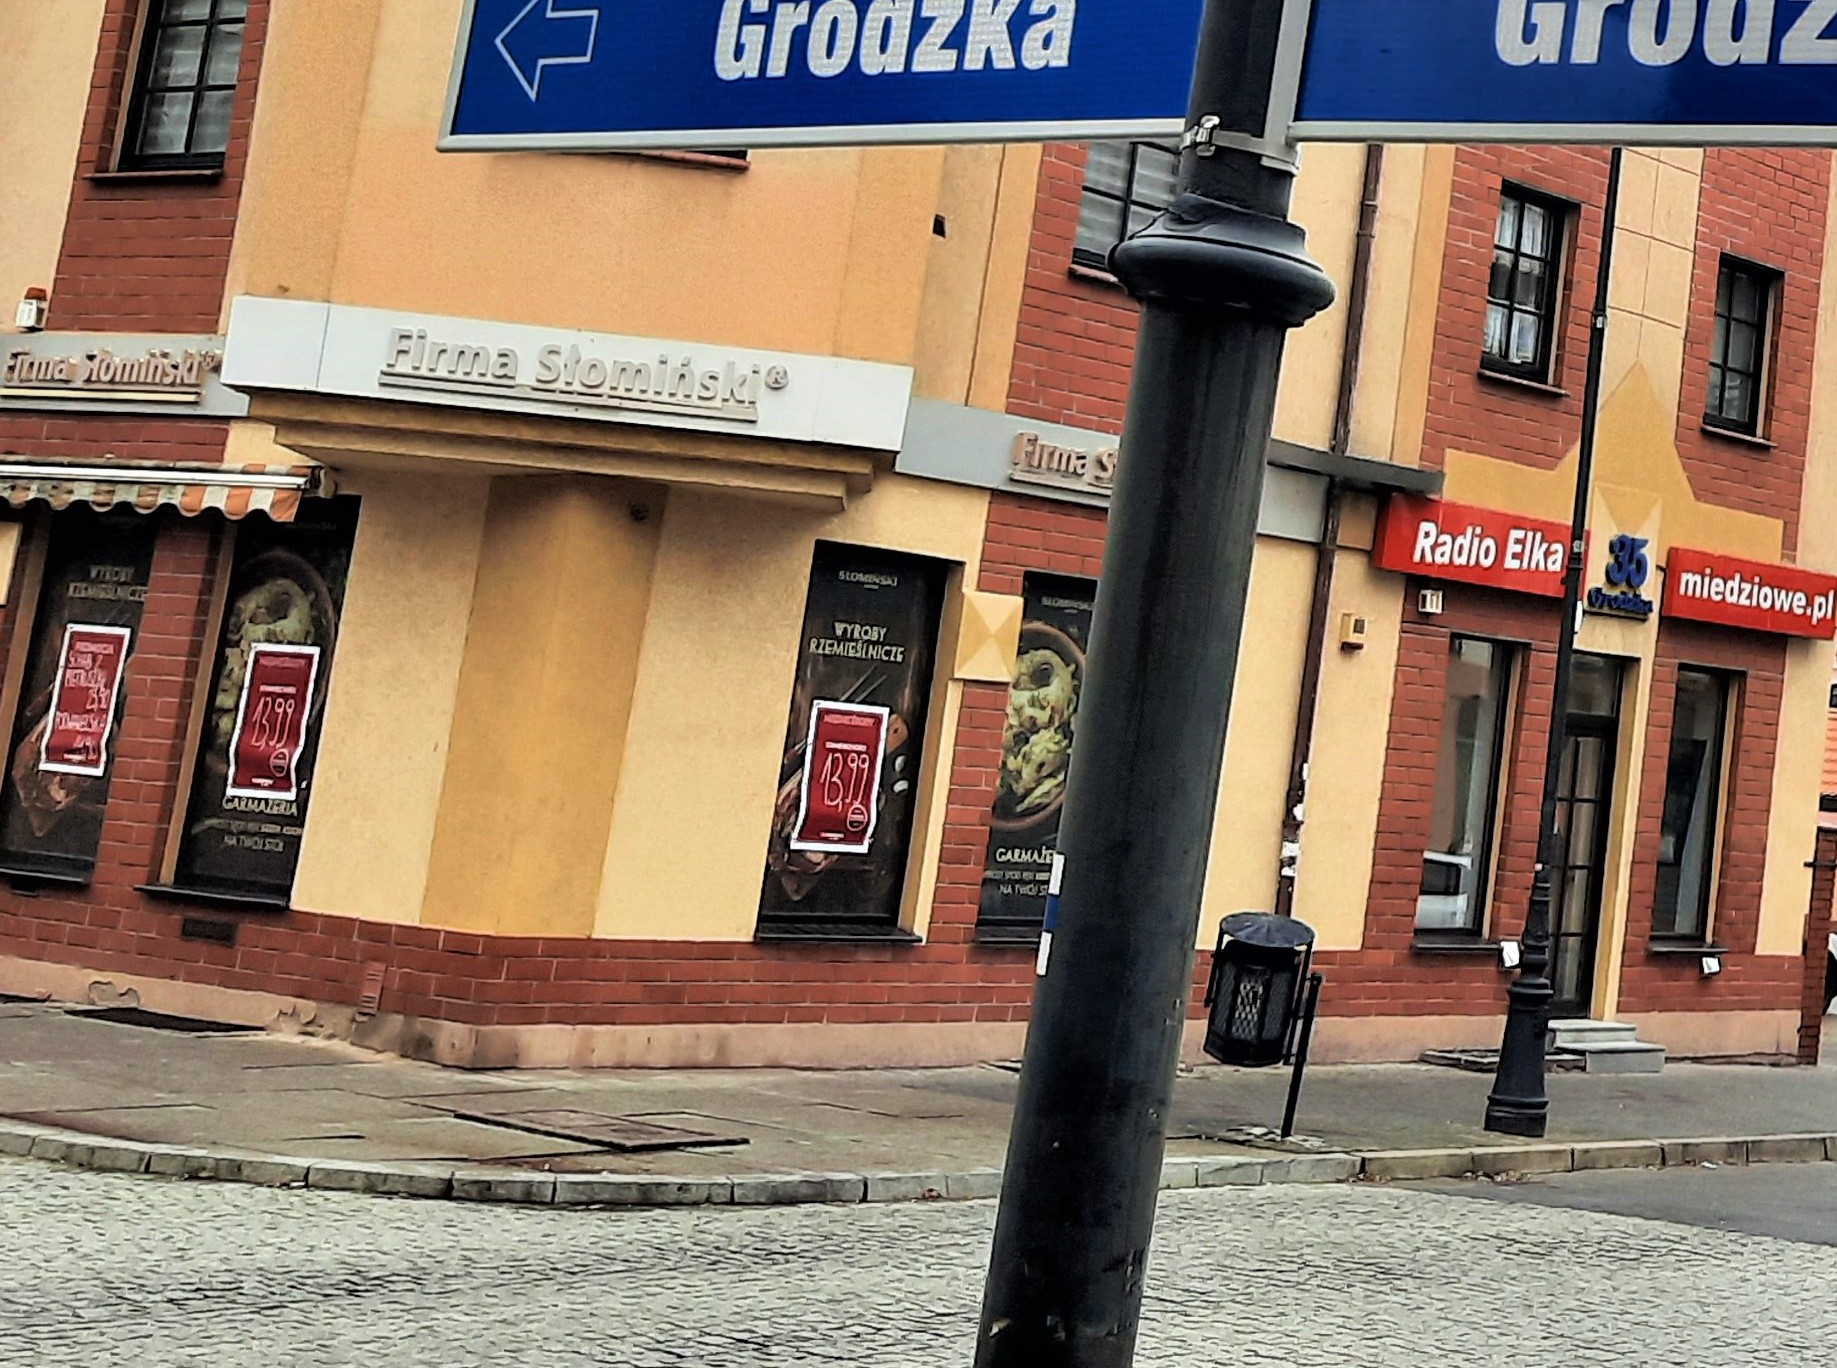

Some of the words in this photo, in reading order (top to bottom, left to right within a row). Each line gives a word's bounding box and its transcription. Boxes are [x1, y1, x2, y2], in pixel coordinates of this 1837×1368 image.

[386, 327, 518, 379] Firma
[1013, 432, 1088, 475] Firma
[1413, 521, 1496, 569] Radio
[1503, 528, 1565, 572] Elka
[1606, 534, 1649, 589] 35
[1679, 569, 1835, 625] miedziowe.pl
[834, 621, 887, 641] WYROBY
[995, 845, 1055, 863] GARMAŻE
